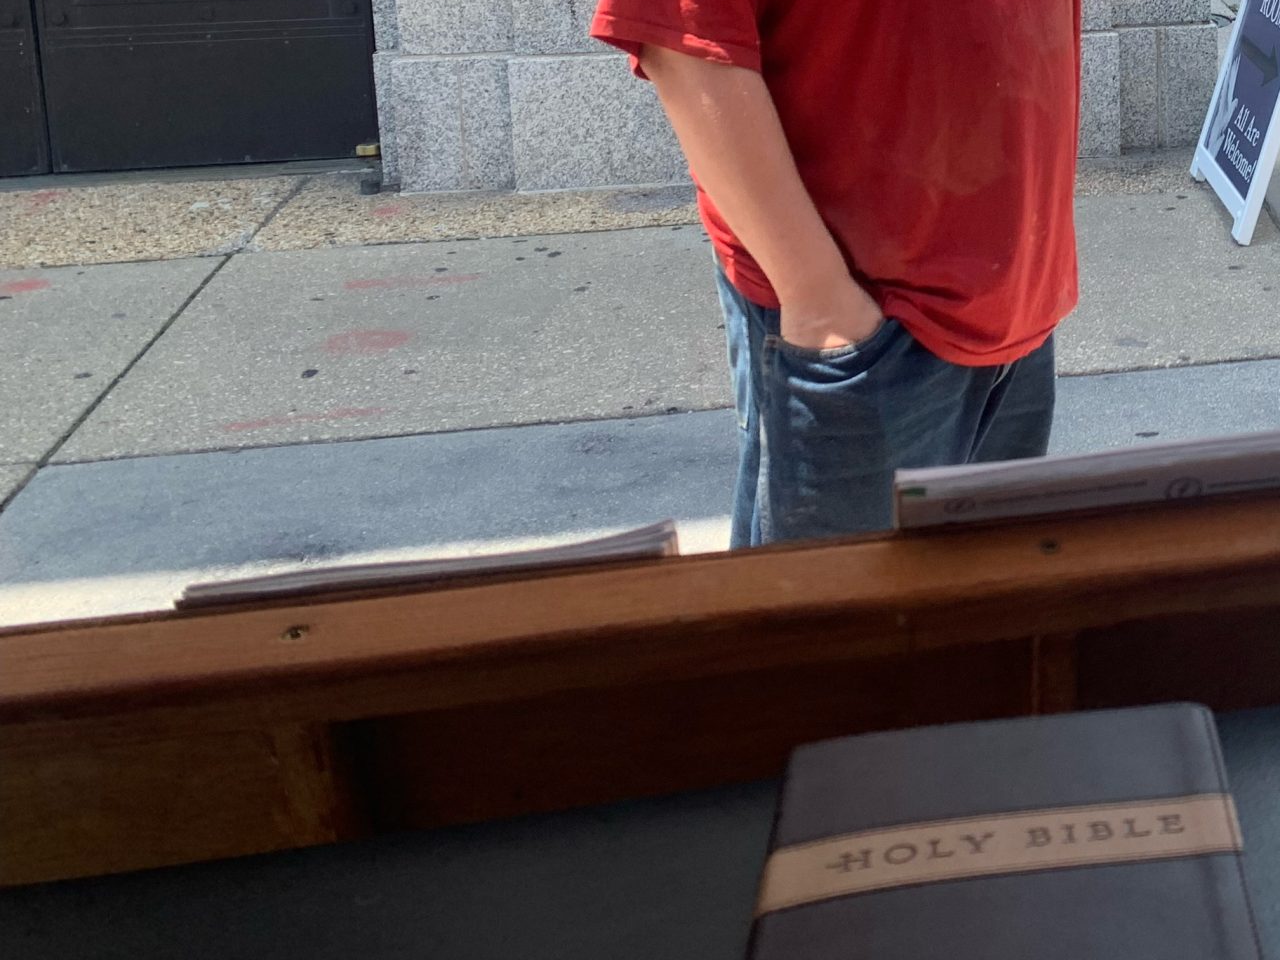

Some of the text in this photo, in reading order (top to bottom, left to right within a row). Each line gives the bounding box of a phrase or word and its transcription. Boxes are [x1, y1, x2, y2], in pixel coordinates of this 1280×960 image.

[1233, 104, 1260, 147] All Are
[1222, 127, 1257, 183] Welcome!
[826, 813, 1187, 874] HOLY BIBLE
